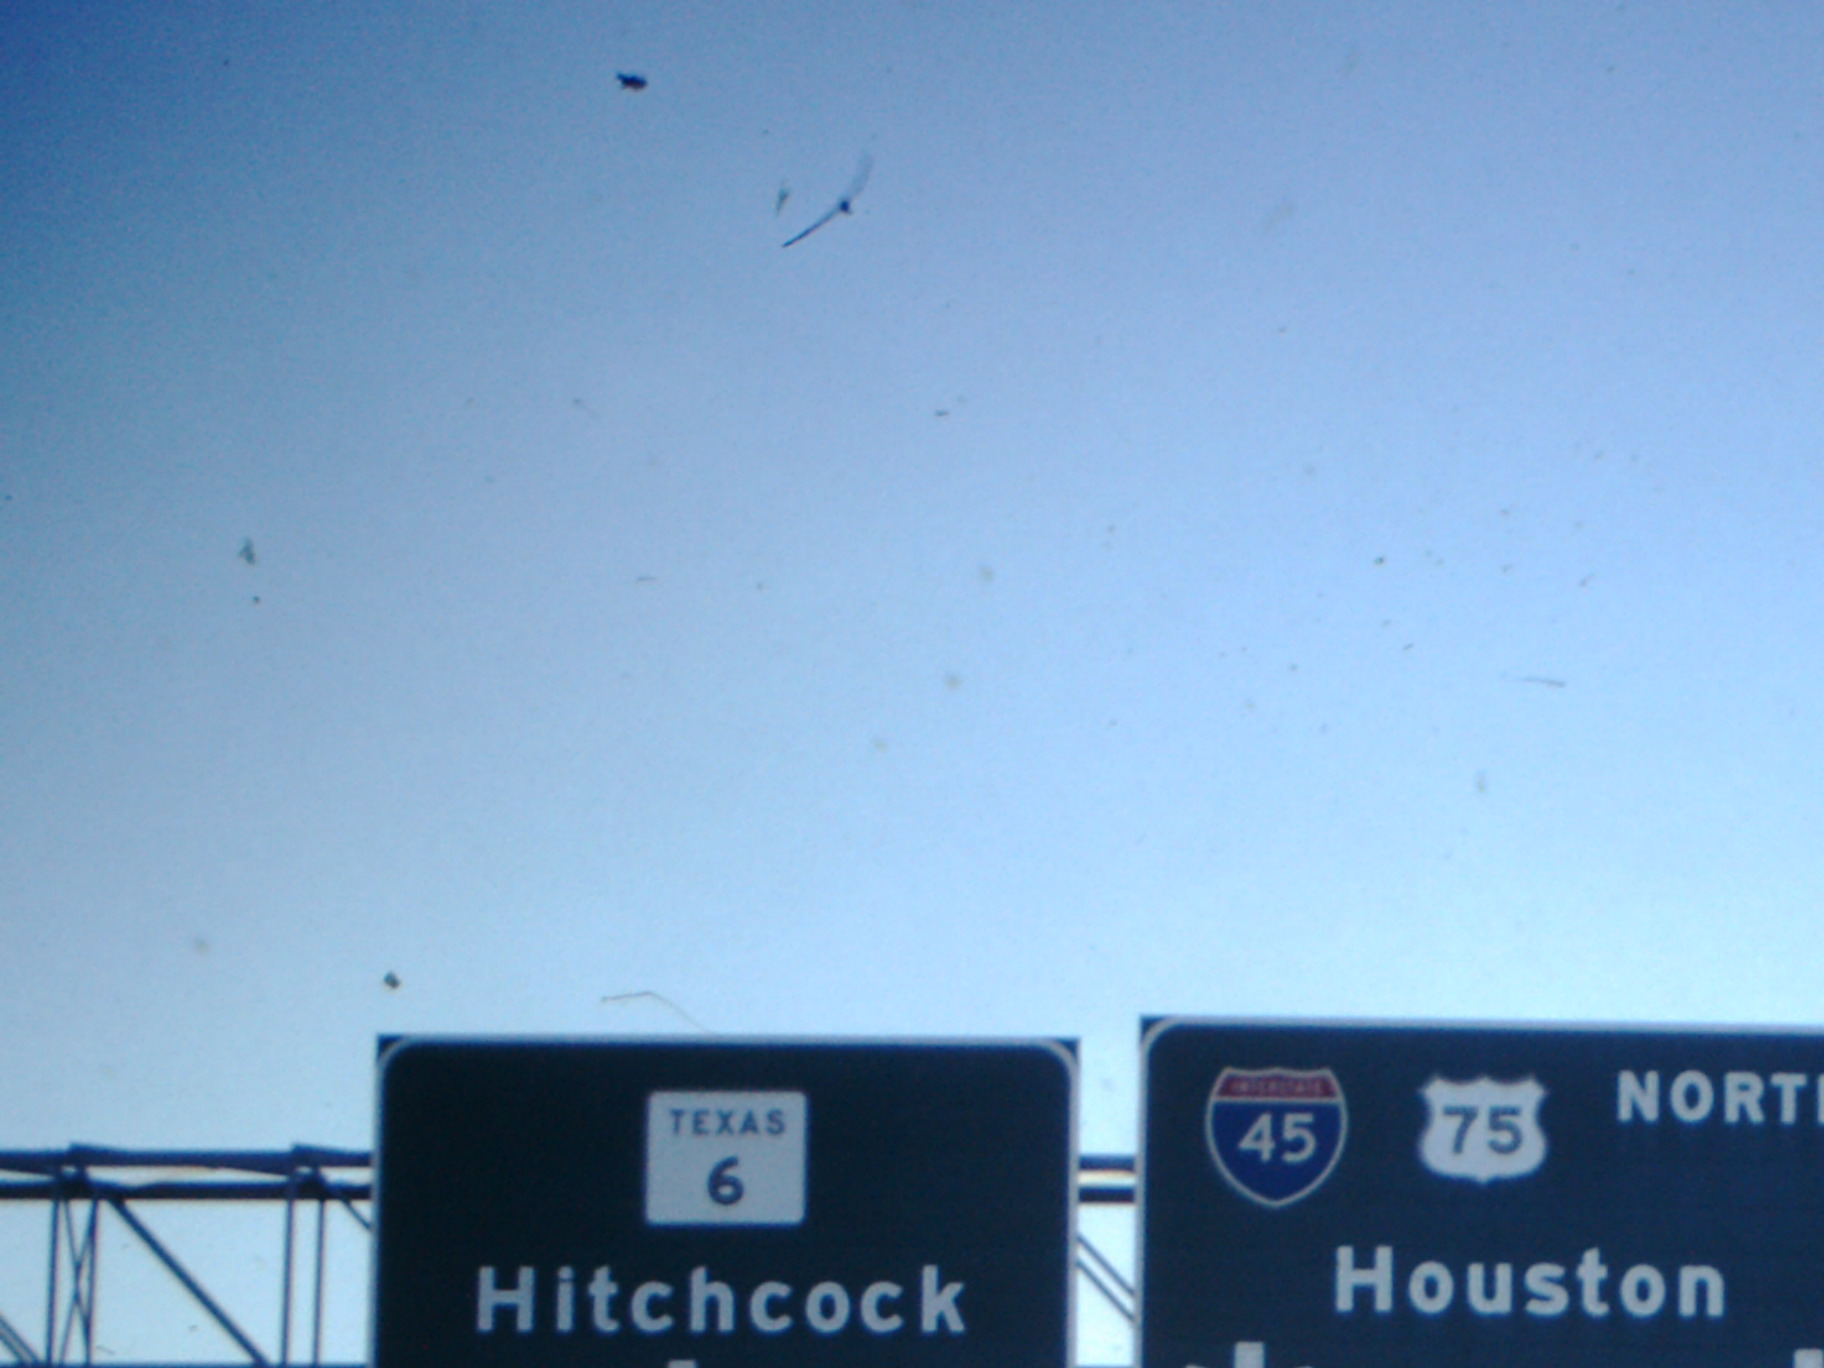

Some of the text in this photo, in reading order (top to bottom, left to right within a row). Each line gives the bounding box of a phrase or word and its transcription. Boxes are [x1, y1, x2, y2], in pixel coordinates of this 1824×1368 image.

[669, 1108, 786, 1137] TEXAS
[1238, 1112, 1317, 1164] 45
[1442, 1105, 1523, 1156] 75
[706, 1156, 745, 1207] 6
[477, 1264, 966, 1334] Hitchcock
[1335, 1245, 1724, 1318] Houston
